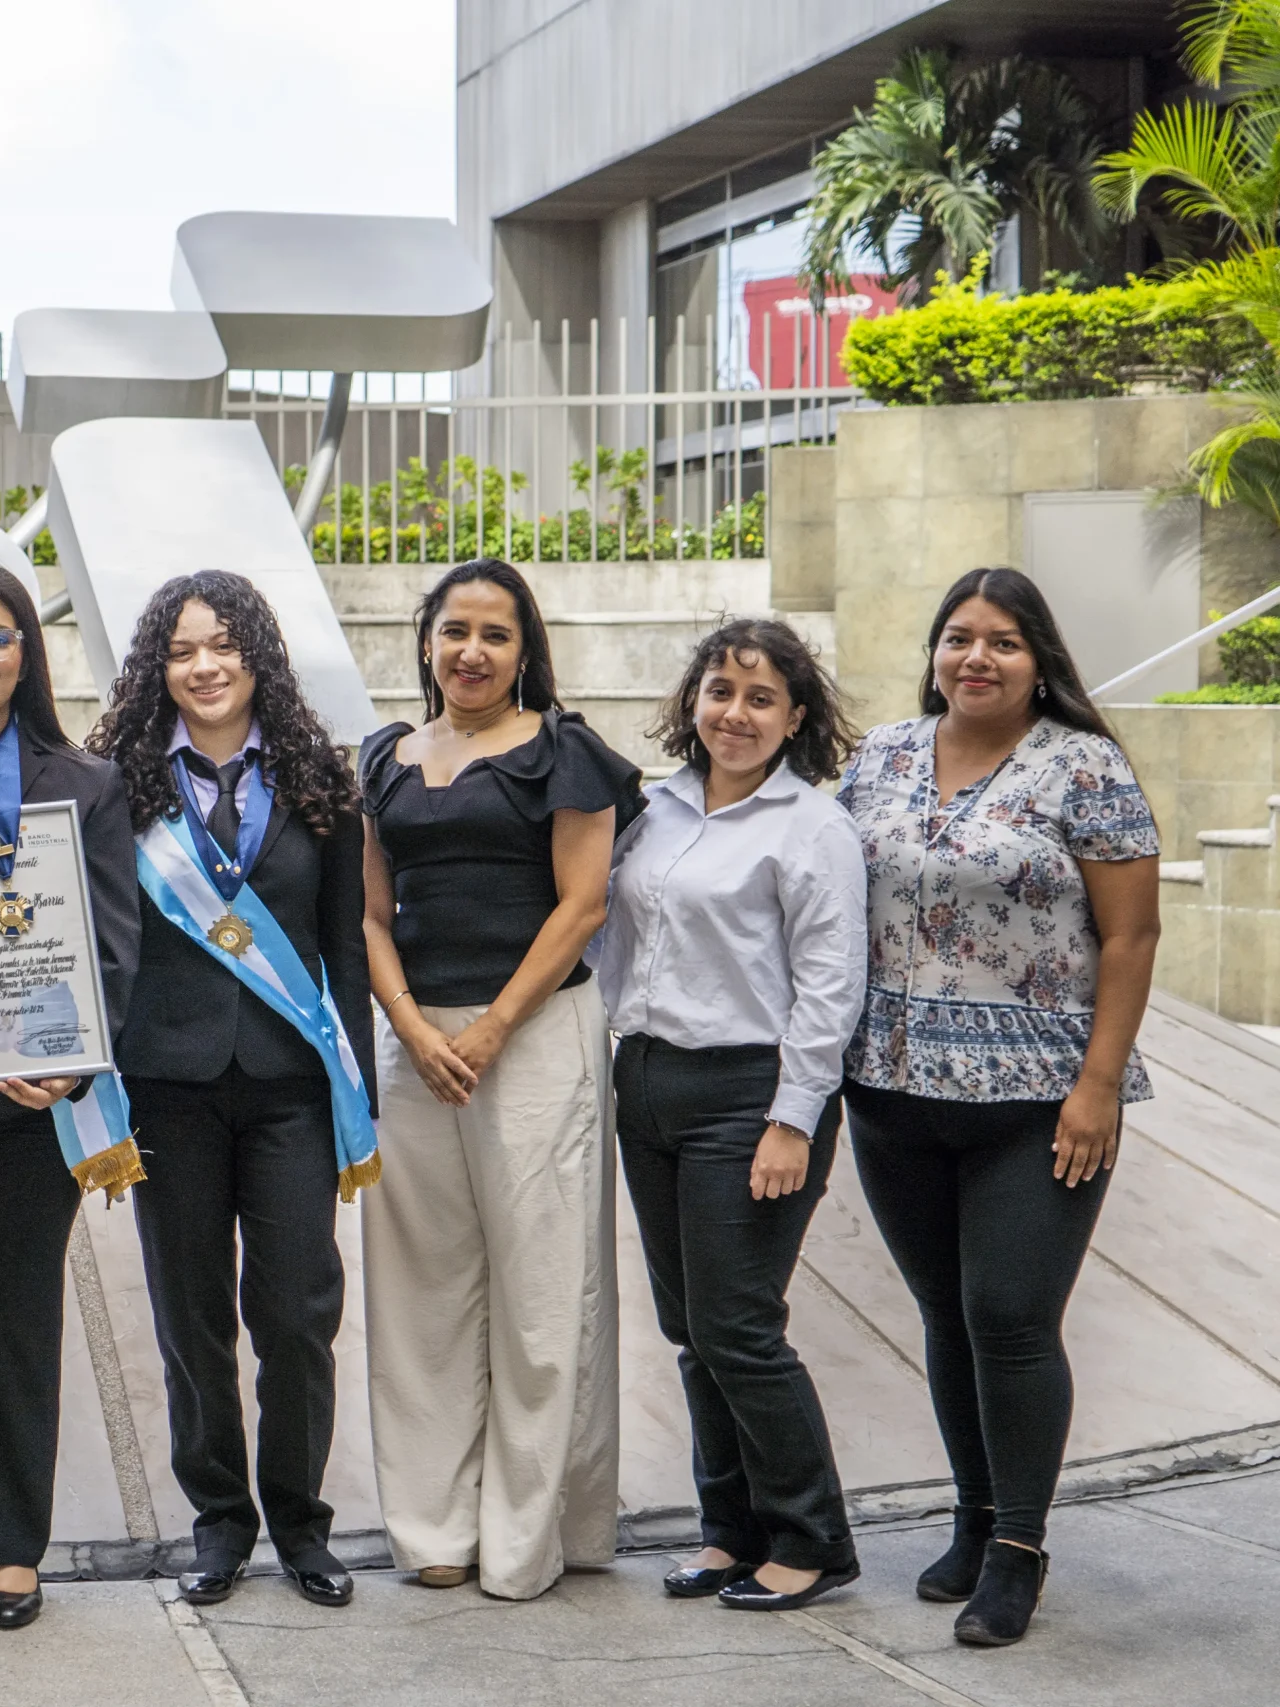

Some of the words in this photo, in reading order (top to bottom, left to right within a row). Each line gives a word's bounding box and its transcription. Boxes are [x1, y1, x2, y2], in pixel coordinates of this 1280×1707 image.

[27, 833, 51, 841] BANCO
[28, 838, 68, 846] INDUSTRIAL
[33, 892, 65, 909] Barrios
